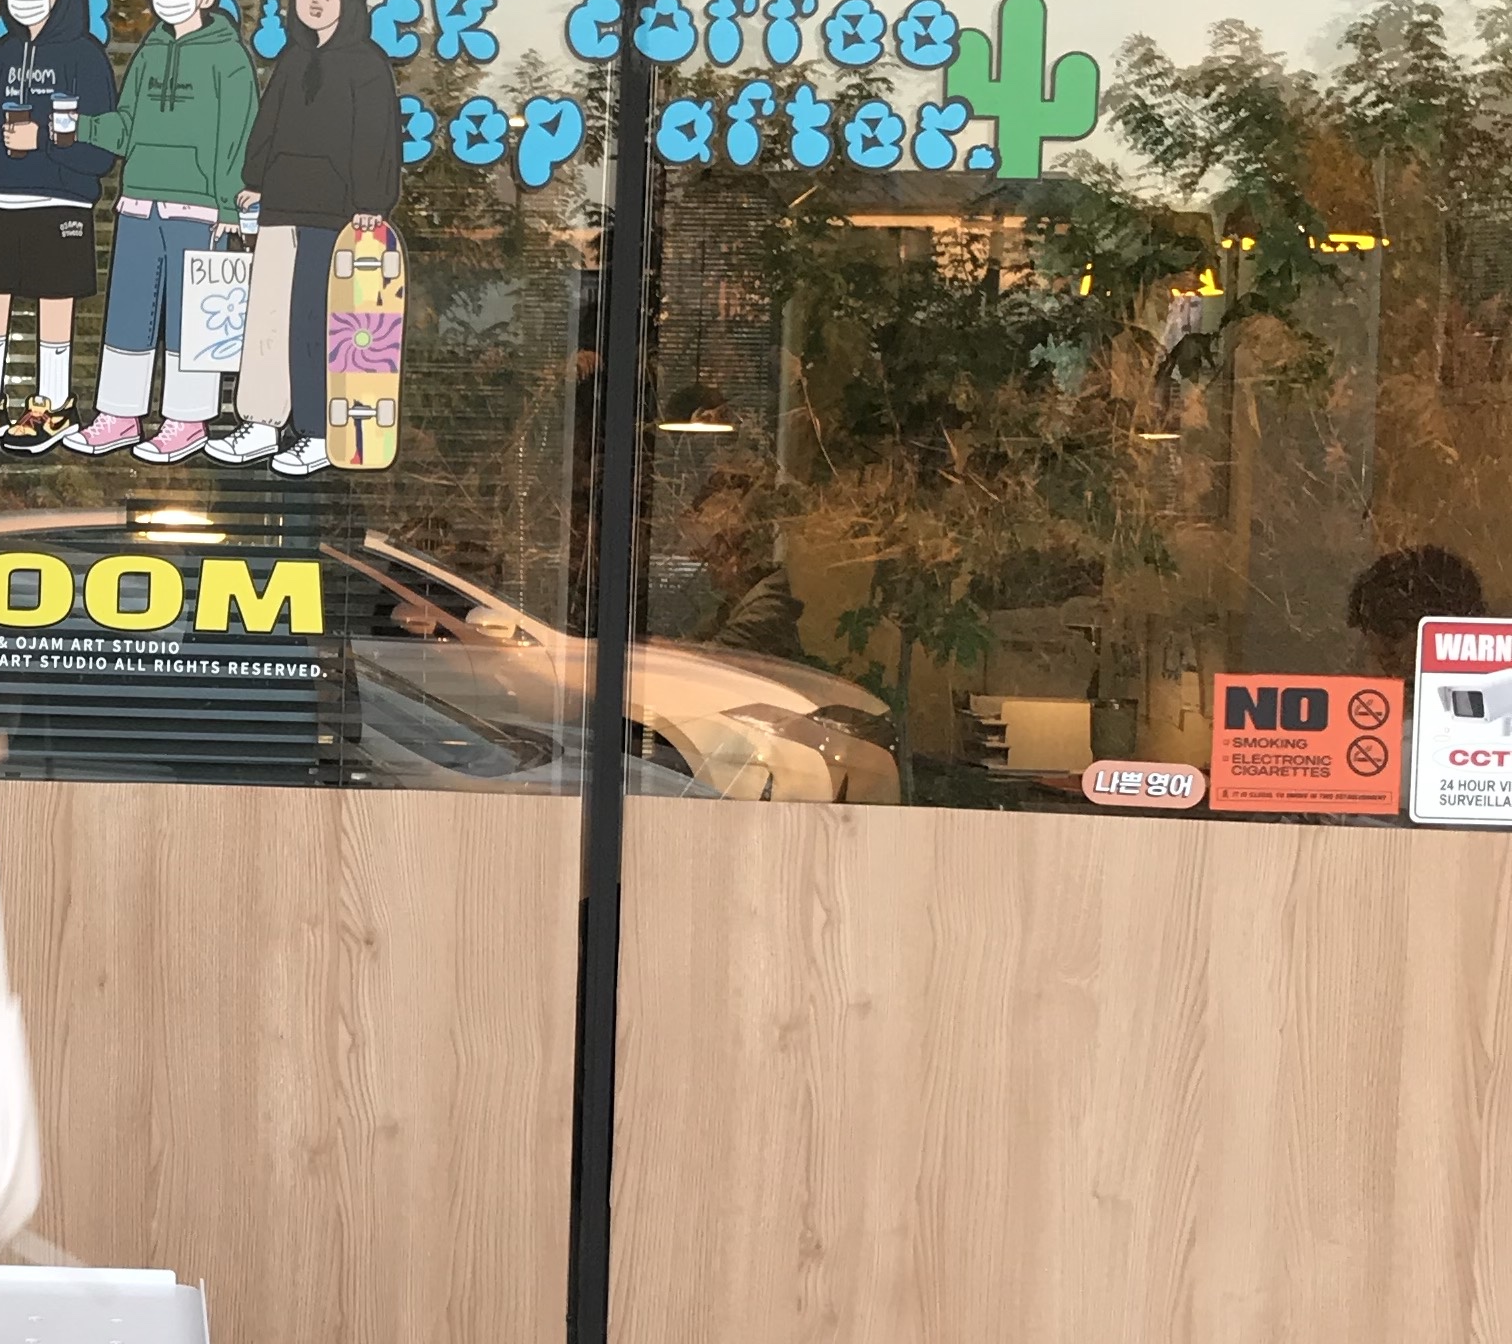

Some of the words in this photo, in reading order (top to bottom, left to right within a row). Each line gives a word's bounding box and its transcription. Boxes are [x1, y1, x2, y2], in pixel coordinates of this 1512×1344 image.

[399, 94, 586, 189] eep
[656, 80, 999, 172] after.
[190, 257, 253, 285] BLOO
[15, 636, 63, 652] OJAM
[70, 638, 105, 652] ART
[112, 639, 180, 655] STUDIO
[39, 654, 108, 670] STUDIO
[114, 658, 147, 672] ALL
[154, 659, 221, 674] RIGHTS
[228, 661, 328, 678] RESERVED.
[1224, 686, 1329, 732] NO
[1232, 737, 1308, 750] SMOKING
[1231, 753, 1332, 767] ELECTRONIC
[1231, 765, 1331, 778] CIGARETTES
[1094, 770, 1143, 795] 나쁜
[1146, 772, 1194, 797] 영어
[1439, 778, 1454, 792] 24
[1458, 779, 1495, 792] HOUR
